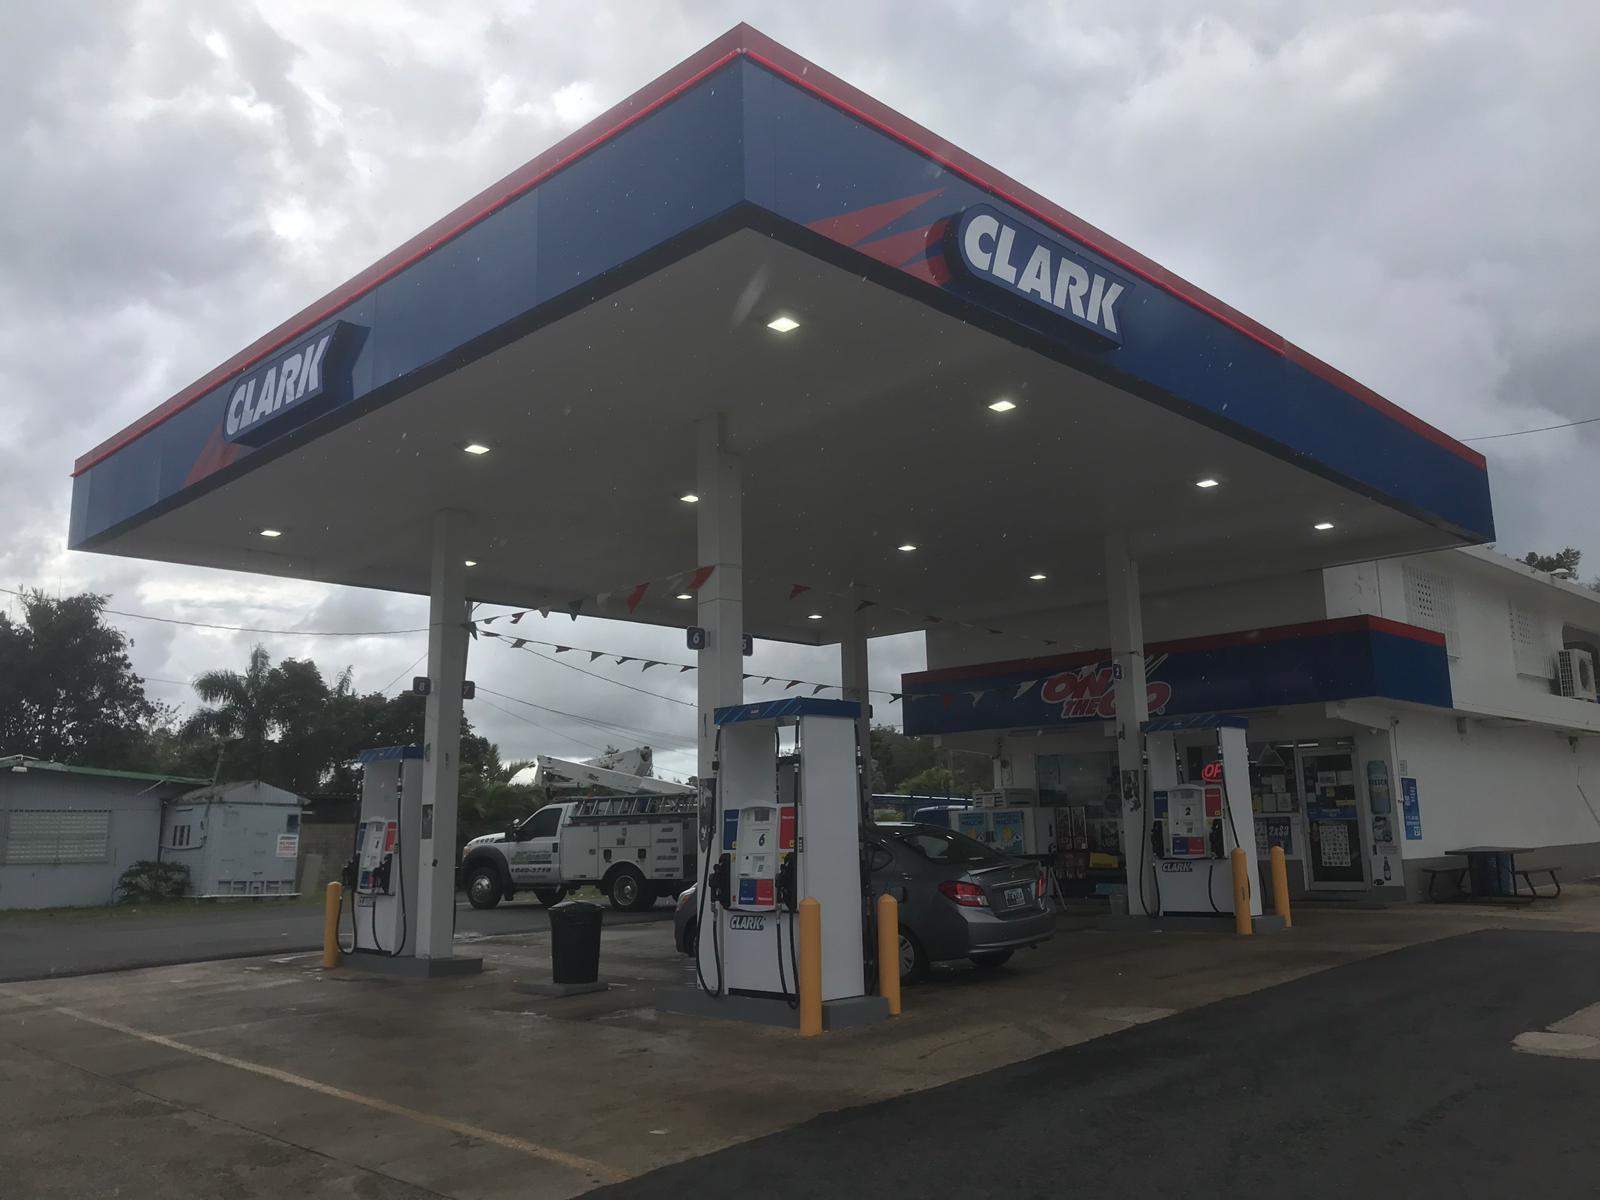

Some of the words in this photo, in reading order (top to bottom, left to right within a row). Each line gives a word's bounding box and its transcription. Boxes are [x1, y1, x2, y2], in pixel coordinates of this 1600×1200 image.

[965, 214, 1125, 334] CLARK
[226, 335, 330, 436] CLARK
[692, 632, 700, 645] 6
[1041, 667, 1114, 704] ON
[758, 833, 766, 846] 6
[1163, 862, 1191, 872] CLARK
[730, 916, 762, 930] CLARK
